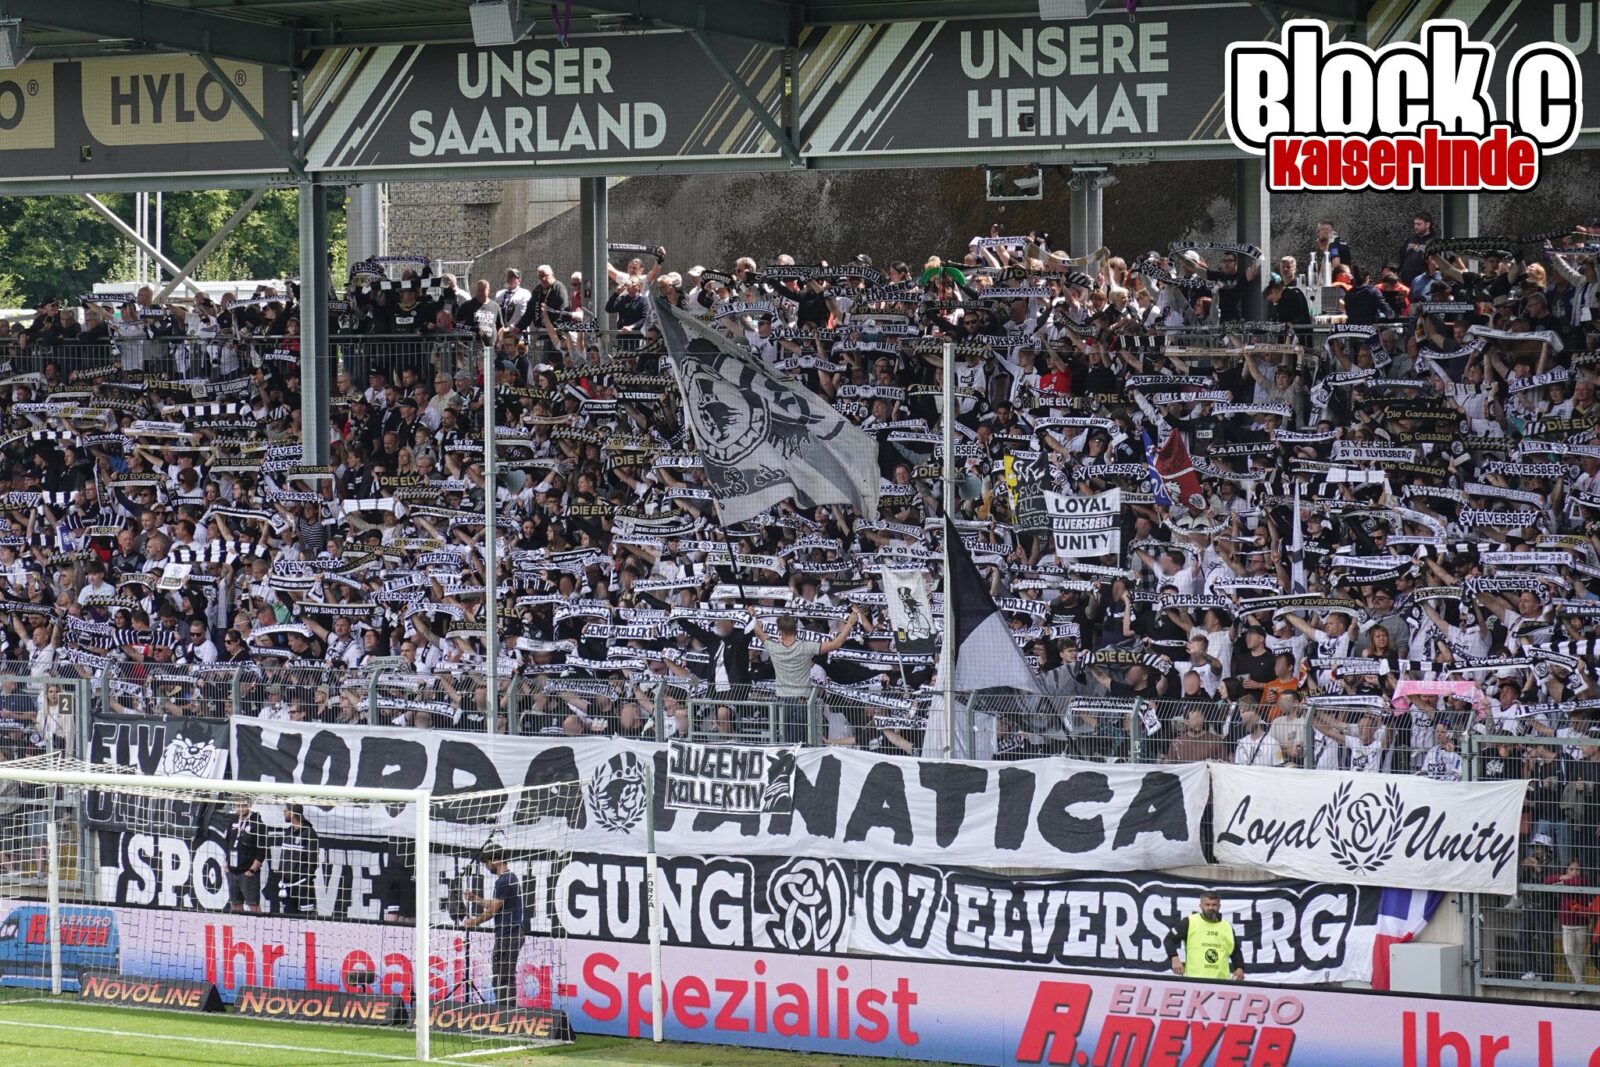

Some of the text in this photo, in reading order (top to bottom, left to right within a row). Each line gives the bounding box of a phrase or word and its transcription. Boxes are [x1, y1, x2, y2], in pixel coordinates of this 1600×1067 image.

[1553, 2, 1600, 56] U
[960, 22, 1169, 79] UNSERE
[458, 47, 613, 98] UNSER
[967, 84, 1168, 139] HEIMAT
[409, 103, 667, 157] SAARLAND
[784, 328, 837, 341] ELVERBERG
[510, 387, 528, 397] DIE
[842, 386, 857, 396] ELV
[1098, 393, 1118, 403] DIE
[1039, 397, 1074, 407] DIE ELV.
[1387, 410, 1402, 419] Die
[193, 420, 257, 428] SAARLAND
[1546, 418, 1569, 430] DIE
[1400, 432, 1413, 443] Die
[1210, 443, 1276, 455] SAARLAND
[1365, 449, 1412, 459] ELVERSBERG
[615, 455, 634, 466] DIE
[1380, 462, 1396, 471] Die
[918, 467, 939, 478] DIE
[1073, 463, 1149, 480] SV ELVERSBERG
[1505, 462, 1568, 476] ELVERSBERG
[381, 476, 399, 486] DIE
[1476, 484, 1540, 501] ELVERSBERG
[572, 505, 592, 515] DIE
[1055, 498, 1110, 514] LOYAL
[1053, 515, 1113, 530] ELVERSBERG
[1461, 511, 1536, 525] SV ELVERSBERG
[1056, 532, 1109, 550] UNITY
[1540, 536, 1589, 550] ELVERSBERG
[275, 562, 286, 572] SV
[708, 554, 773, 566] ELVERSBERG
[1480, 579, 1547, 593] ELVERSBERG
[304, 606, 318, 614] WIR
[320, 607, 339, 615] SIND
[1095, 651, 1142, 664] DIE ELV.
[62, 698, 69, 711] 2
[90, 723, 167, 778] ELV
[670, 743, 764, 781] JUGEND
[651, 747, 1188, 853] NATICA
[667, 779, 766, 810] KOLLEKTIV
[85, 788, 205, 826] UNITE
[1217, 795, 1515, 879] Loyal Unity
[127, 832, 1349, 963] SPOVEEIGUNG 07 ELVERSERG
[205, 924, 285, 990] Ihr
[83, 977, 203, 1008] NOVOLINE
[305, 932, 920, 1047] Leasig-Spezialist
[241, 991, 390, 1021] NOVOLINE
[1110, 984, 1304, 1026] ELEKTRO
[1403, 1010, 1509, 1067] Ihr
[1538, 1021, 1600, 1067] L
